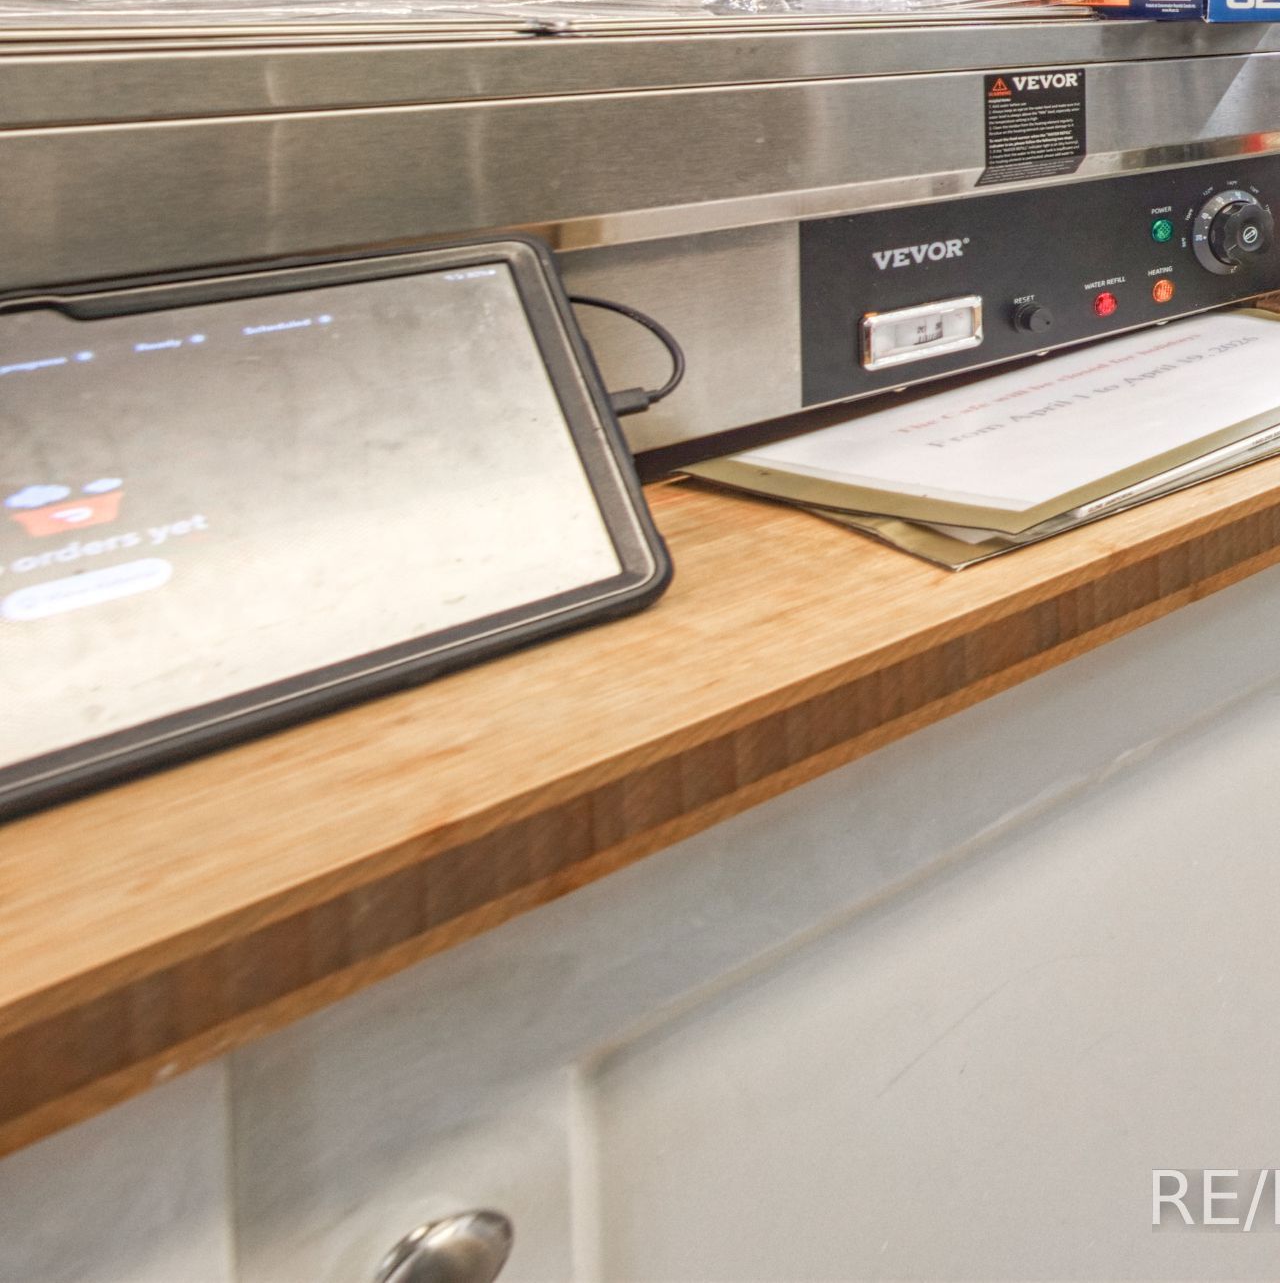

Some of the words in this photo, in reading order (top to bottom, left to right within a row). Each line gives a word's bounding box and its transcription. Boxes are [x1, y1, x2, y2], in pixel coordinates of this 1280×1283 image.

[1151, 206, 1172, 215] POWER
[872, 239, 963, 270] VEVOR
[1148, 265, 1173, 276] HEATING
[1084, 280, 1106, 290] WATER
[1106, 276, 1126, 286] REFILL
[1014, 295, 1035, 304] RESET
[12, 530, 142, 574] orders
[149, 514, 208, 548] yet
